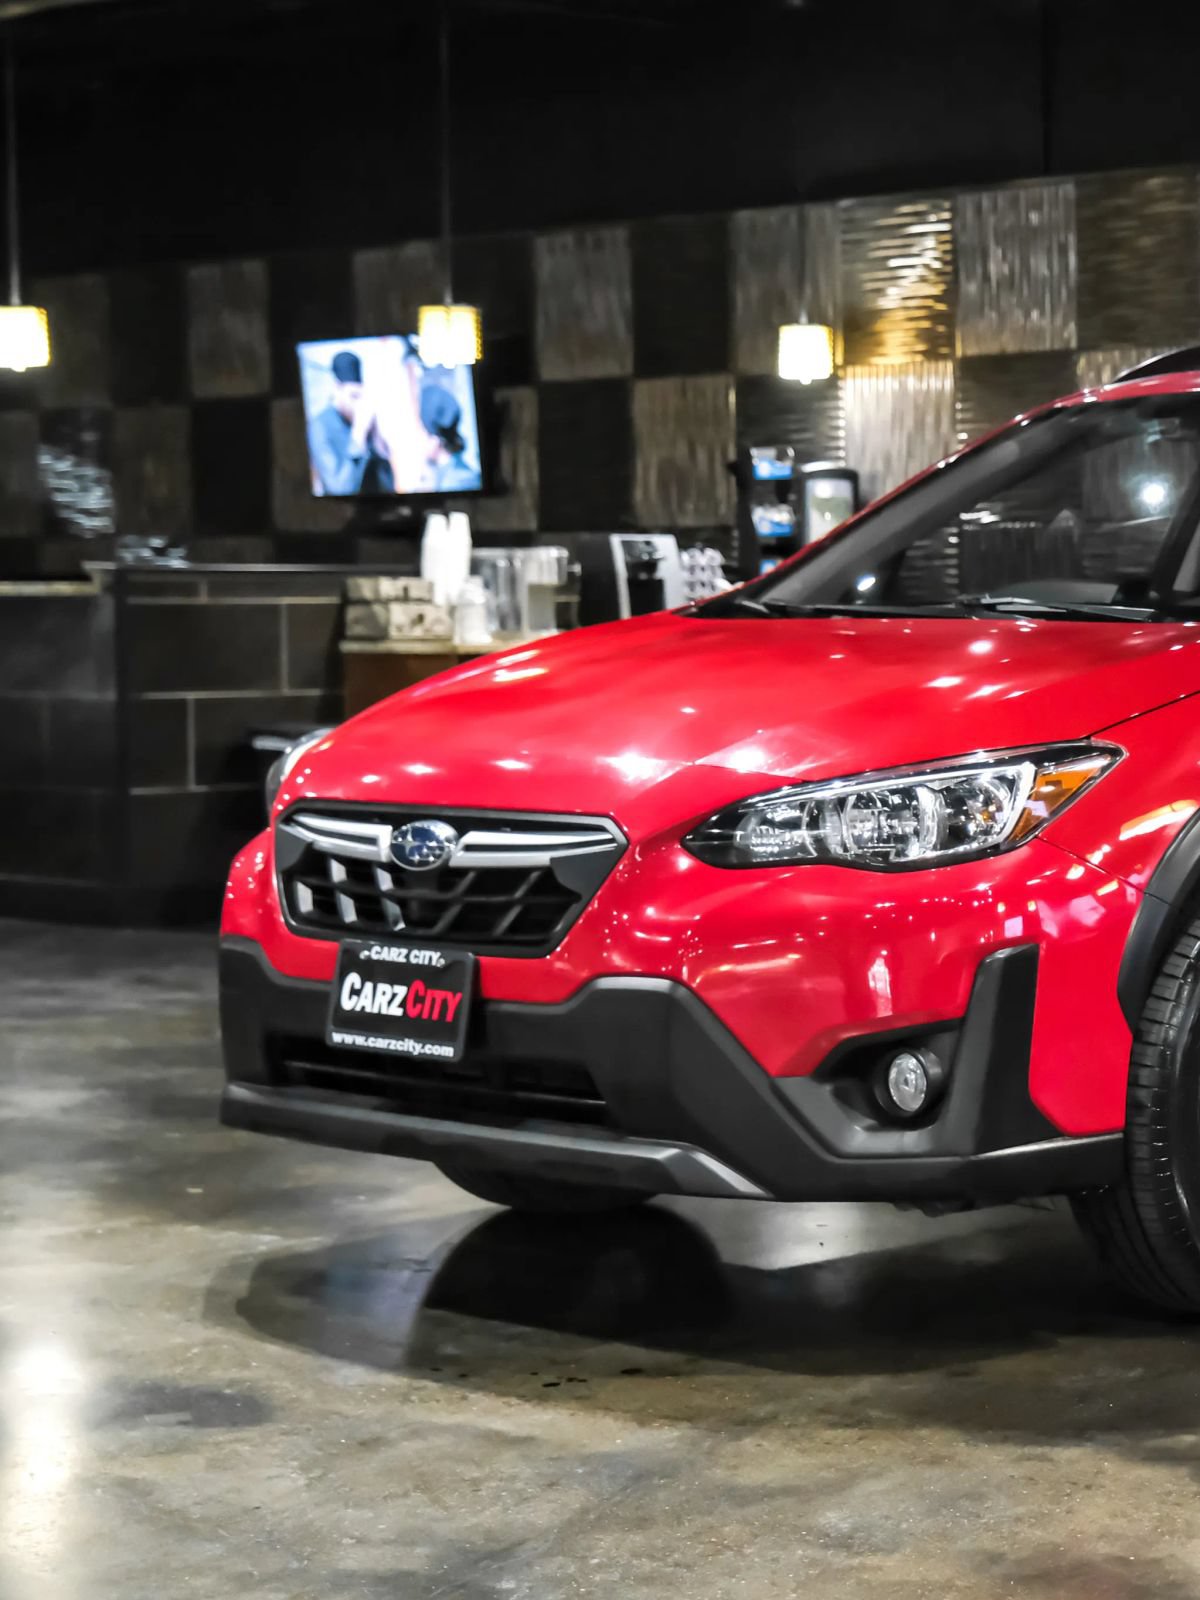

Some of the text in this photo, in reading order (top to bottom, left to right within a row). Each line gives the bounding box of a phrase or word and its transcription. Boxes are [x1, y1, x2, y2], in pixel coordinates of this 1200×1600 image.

[370, 946, 441, 967] CARZ CITY
[332, 1031, 454, 1058] www.carzcity.com
